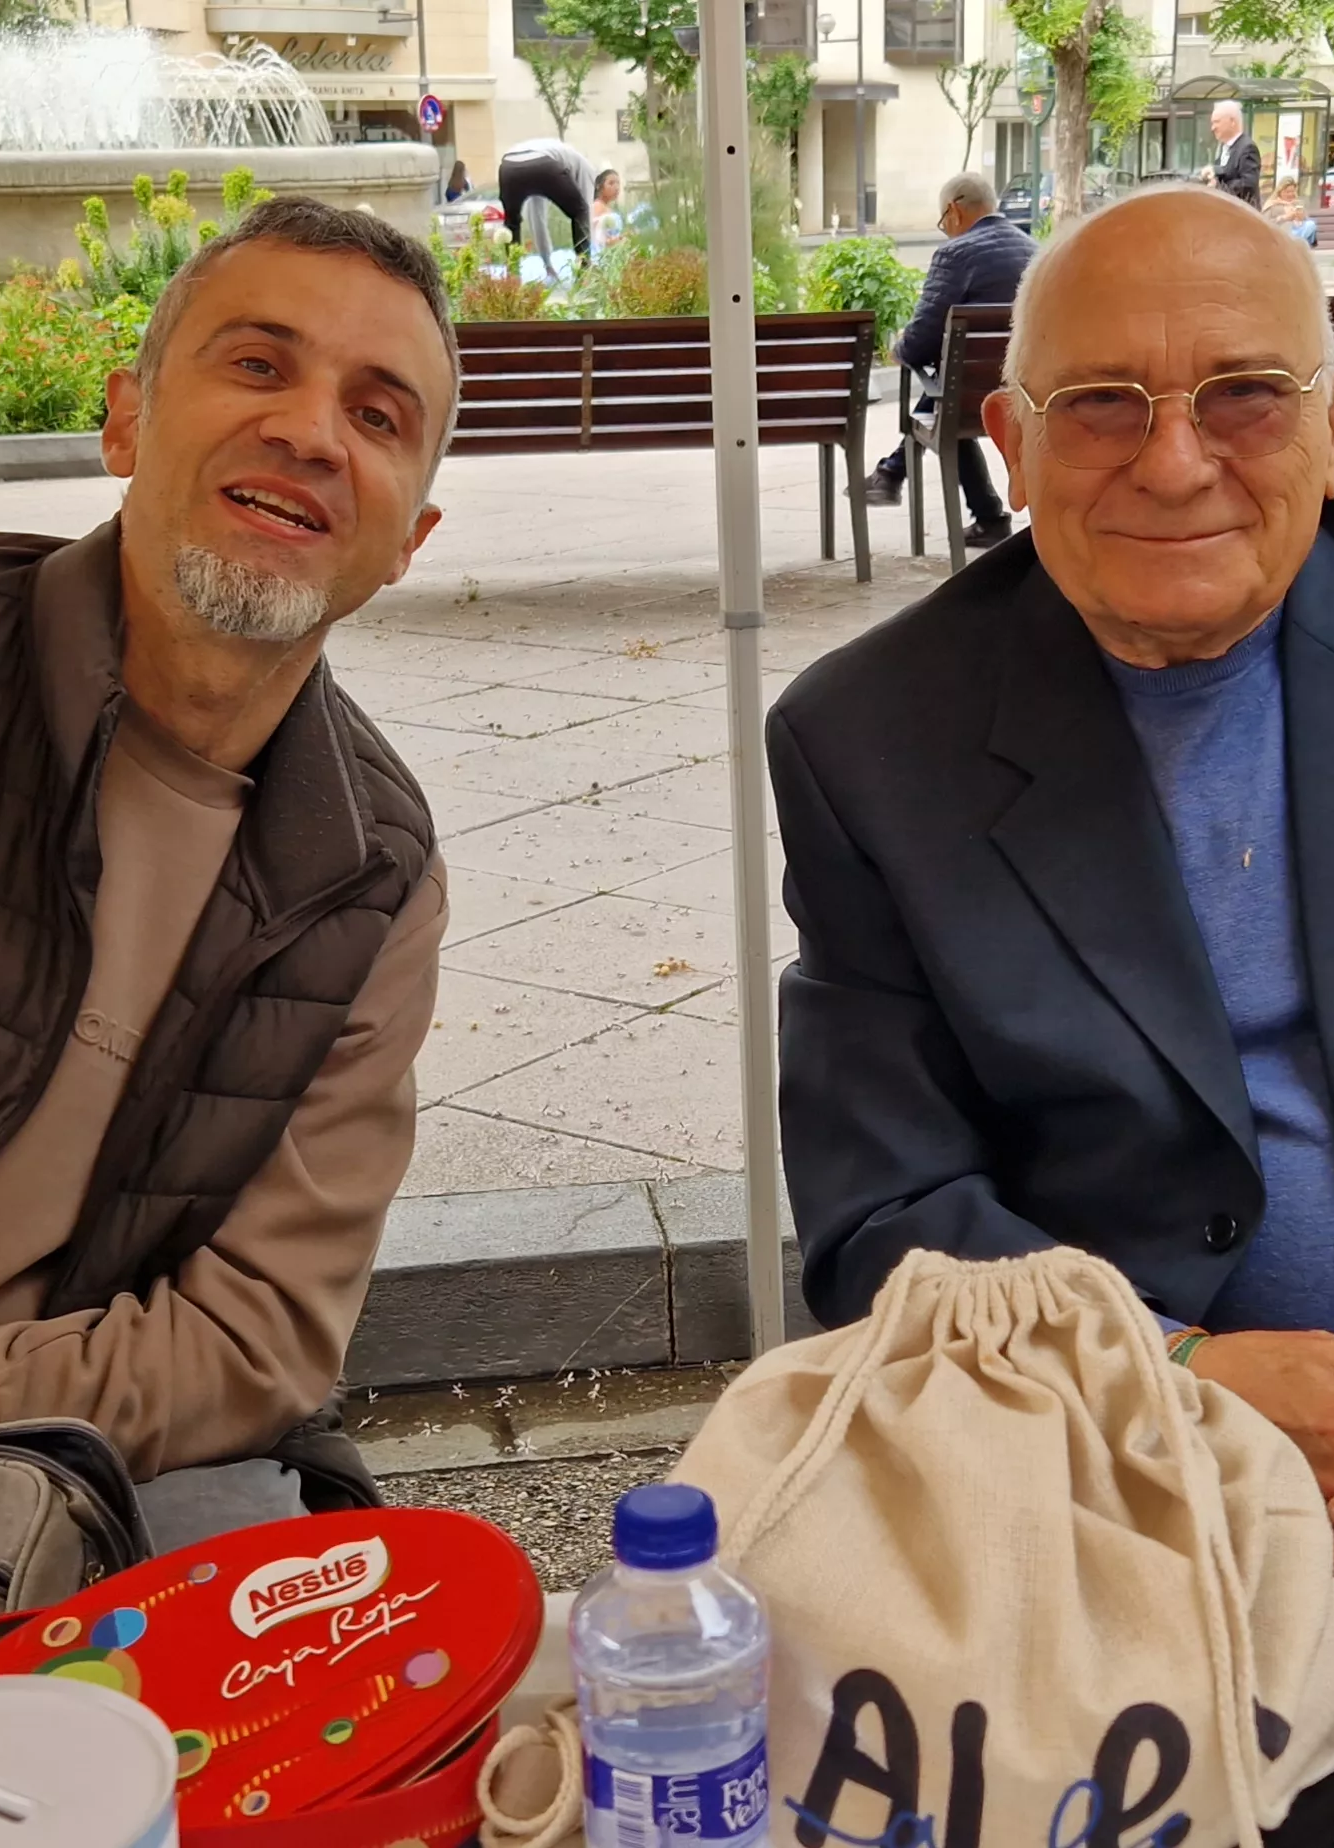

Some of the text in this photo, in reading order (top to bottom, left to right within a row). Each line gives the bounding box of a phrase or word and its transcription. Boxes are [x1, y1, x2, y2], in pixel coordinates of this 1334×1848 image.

[222, 34, 394, 72] Cfetería
[248, 1552, 368, 1615] Nestlé
[221, 1579, 441, 1699] Caja Roja
